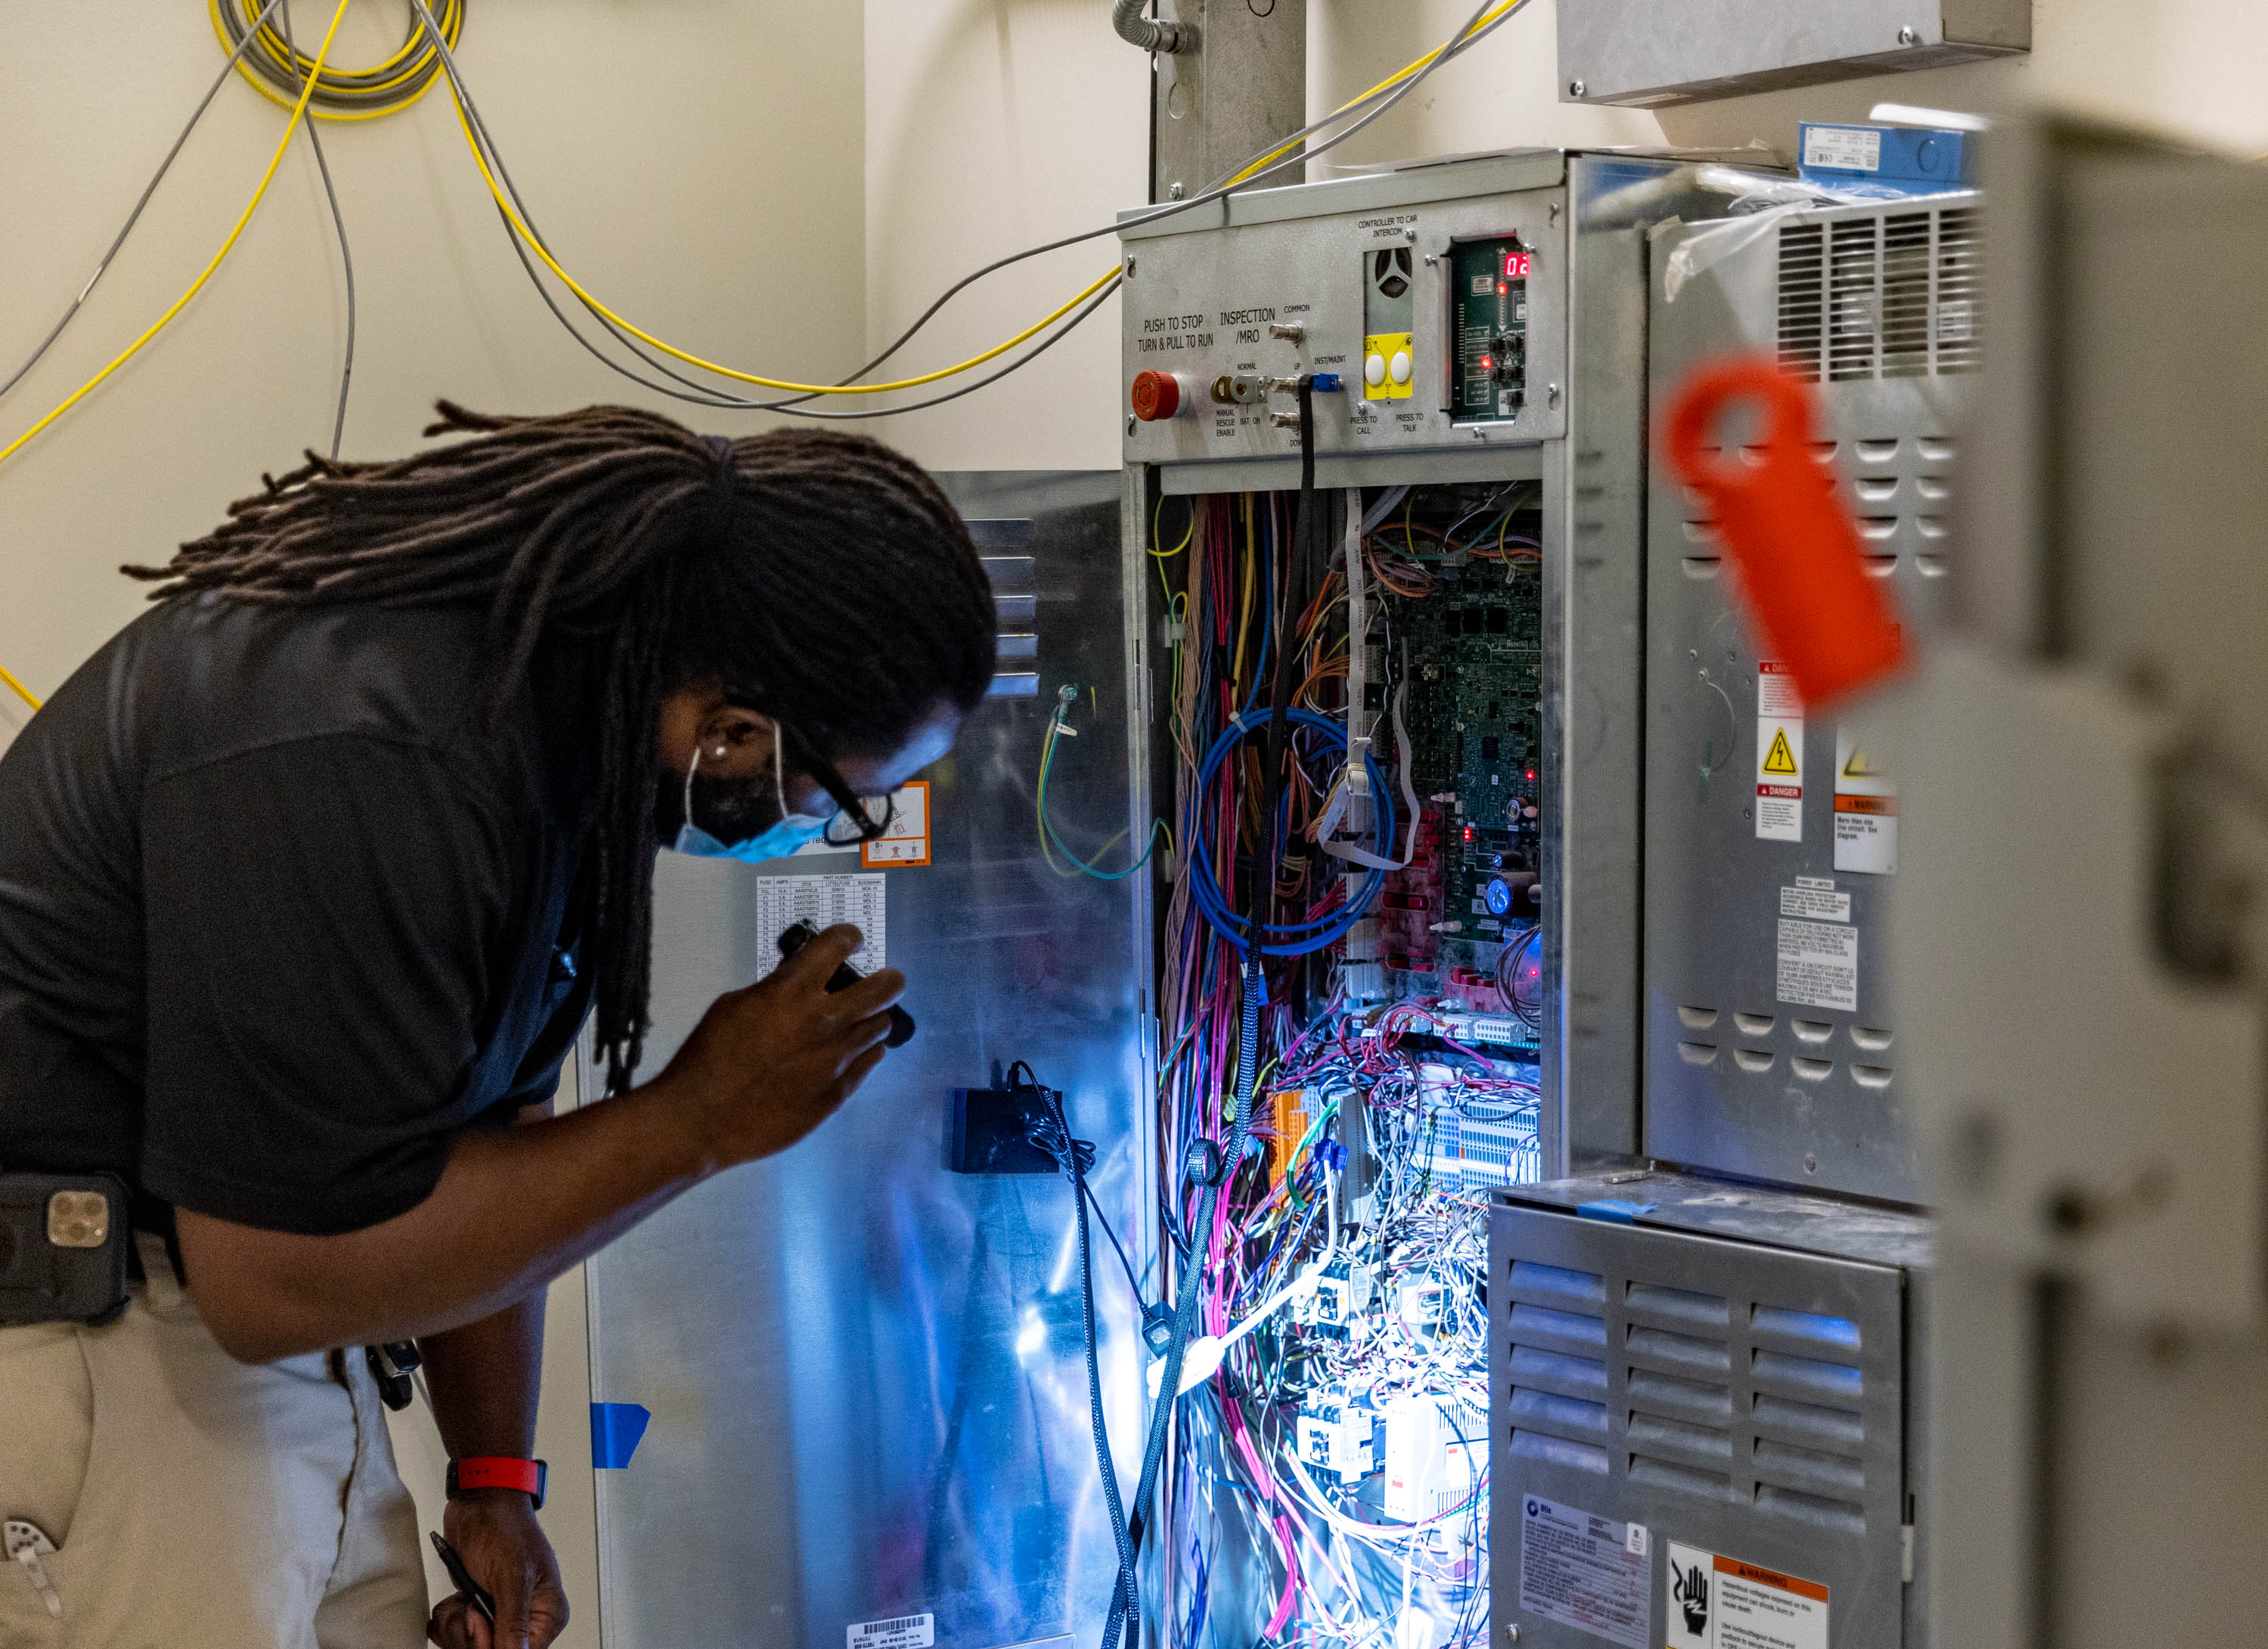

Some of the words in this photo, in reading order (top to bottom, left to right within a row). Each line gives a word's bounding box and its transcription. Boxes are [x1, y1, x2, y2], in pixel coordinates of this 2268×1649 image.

[1359, 217, 1395, 228] CONTROLLER
[1406, 214, 1418, 223] CAR
[1373, 228, 1402, 237] INTERCOM
[1284, 304, 1309, 313] COMMON
[1220, 308, 1275, 325] INSPECTION
[1145, 318, 1165, 333] PUSH
[1168, 318, 1179, 330] TO
[1182, 315, 1203, 329] STOP
[1138, 339, 1157, 352] TURN
[1159, 338, 1165, 350] &
[1167, 336, 1184, 350] PULL
[1185, 335, 1196, 348] TO
[1198, 333, 1213, 346] RUN
[1236, 330, 1259, 344] /MRO
[1314, 355, 1346, 364] INST/MAINT
[1237, 362, 1257, 370] NORMAL
[1216, 418, 1235, 427] RESCUE
[1396, 414, 1414, 422] PRESS
[1770, 786, 1798, 796] DANGER
[1747, 1567, 1788, 1588] WARNING
[1722, 1580, 1748, 1593] Hazardous
[1749, 1589, 1770, 1600] voltages
[1771, 1595, 1792, 1607] exposed
[1801, 1604, 1811, 1613] this
[1722, 1592, 1748, 1603] equipment
[1721, 1632, 1740, 1643] padlock
[1722, 1622, 1731, 1630] Use
[1768, 1637, 1785, 1647] device
